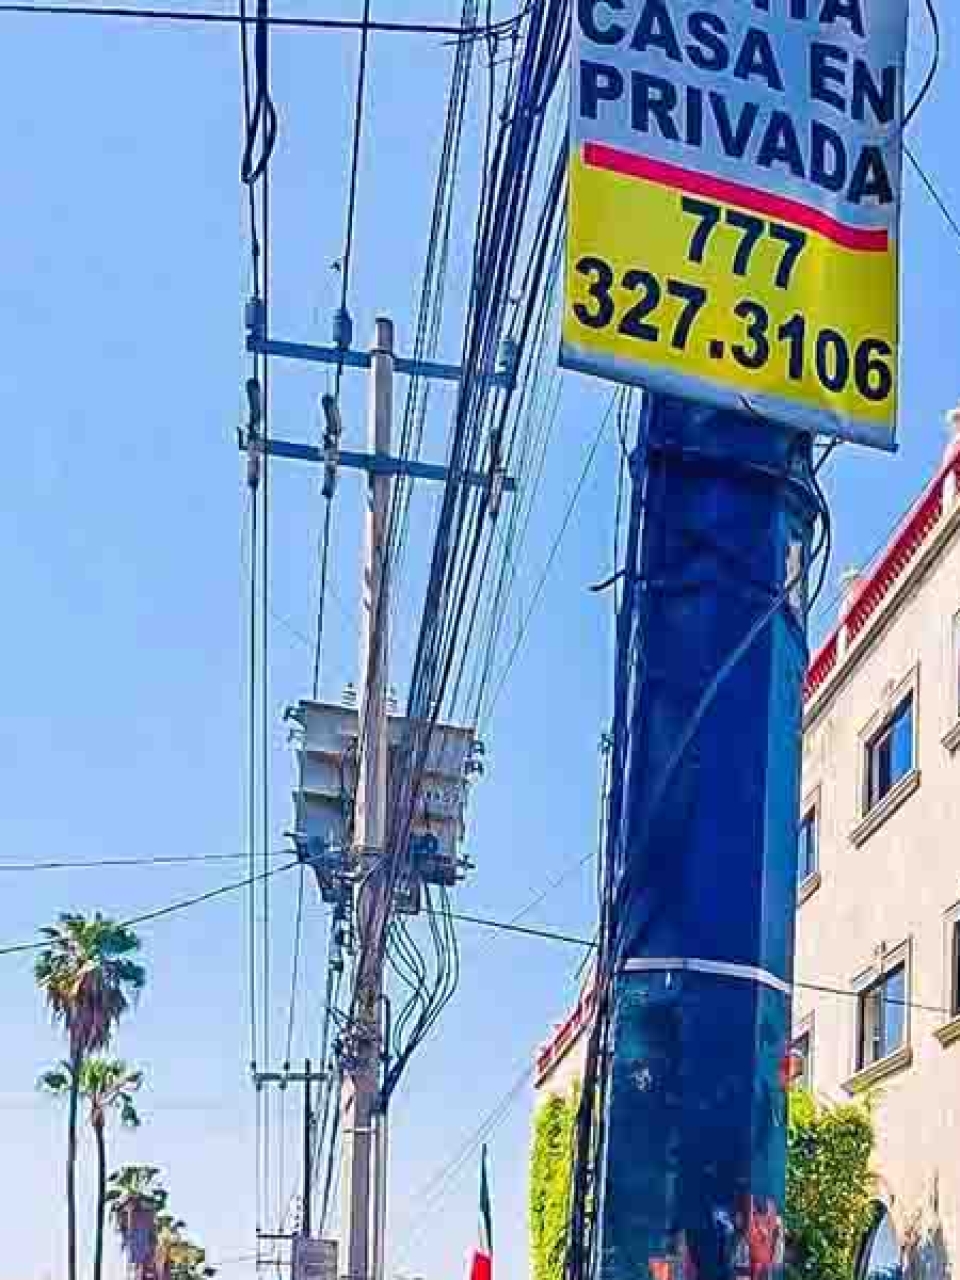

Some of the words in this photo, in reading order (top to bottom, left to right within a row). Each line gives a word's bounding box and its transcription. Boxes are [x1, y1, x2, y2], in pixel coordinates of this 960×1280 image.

[577, 0, 787, 92] CASA
[809, 42, 897, 124] EN
[579, 59, 894, 205] PRIVADA
[681, 196, 808, 290] 777
[573, 257, 893, 401] 327.3106
